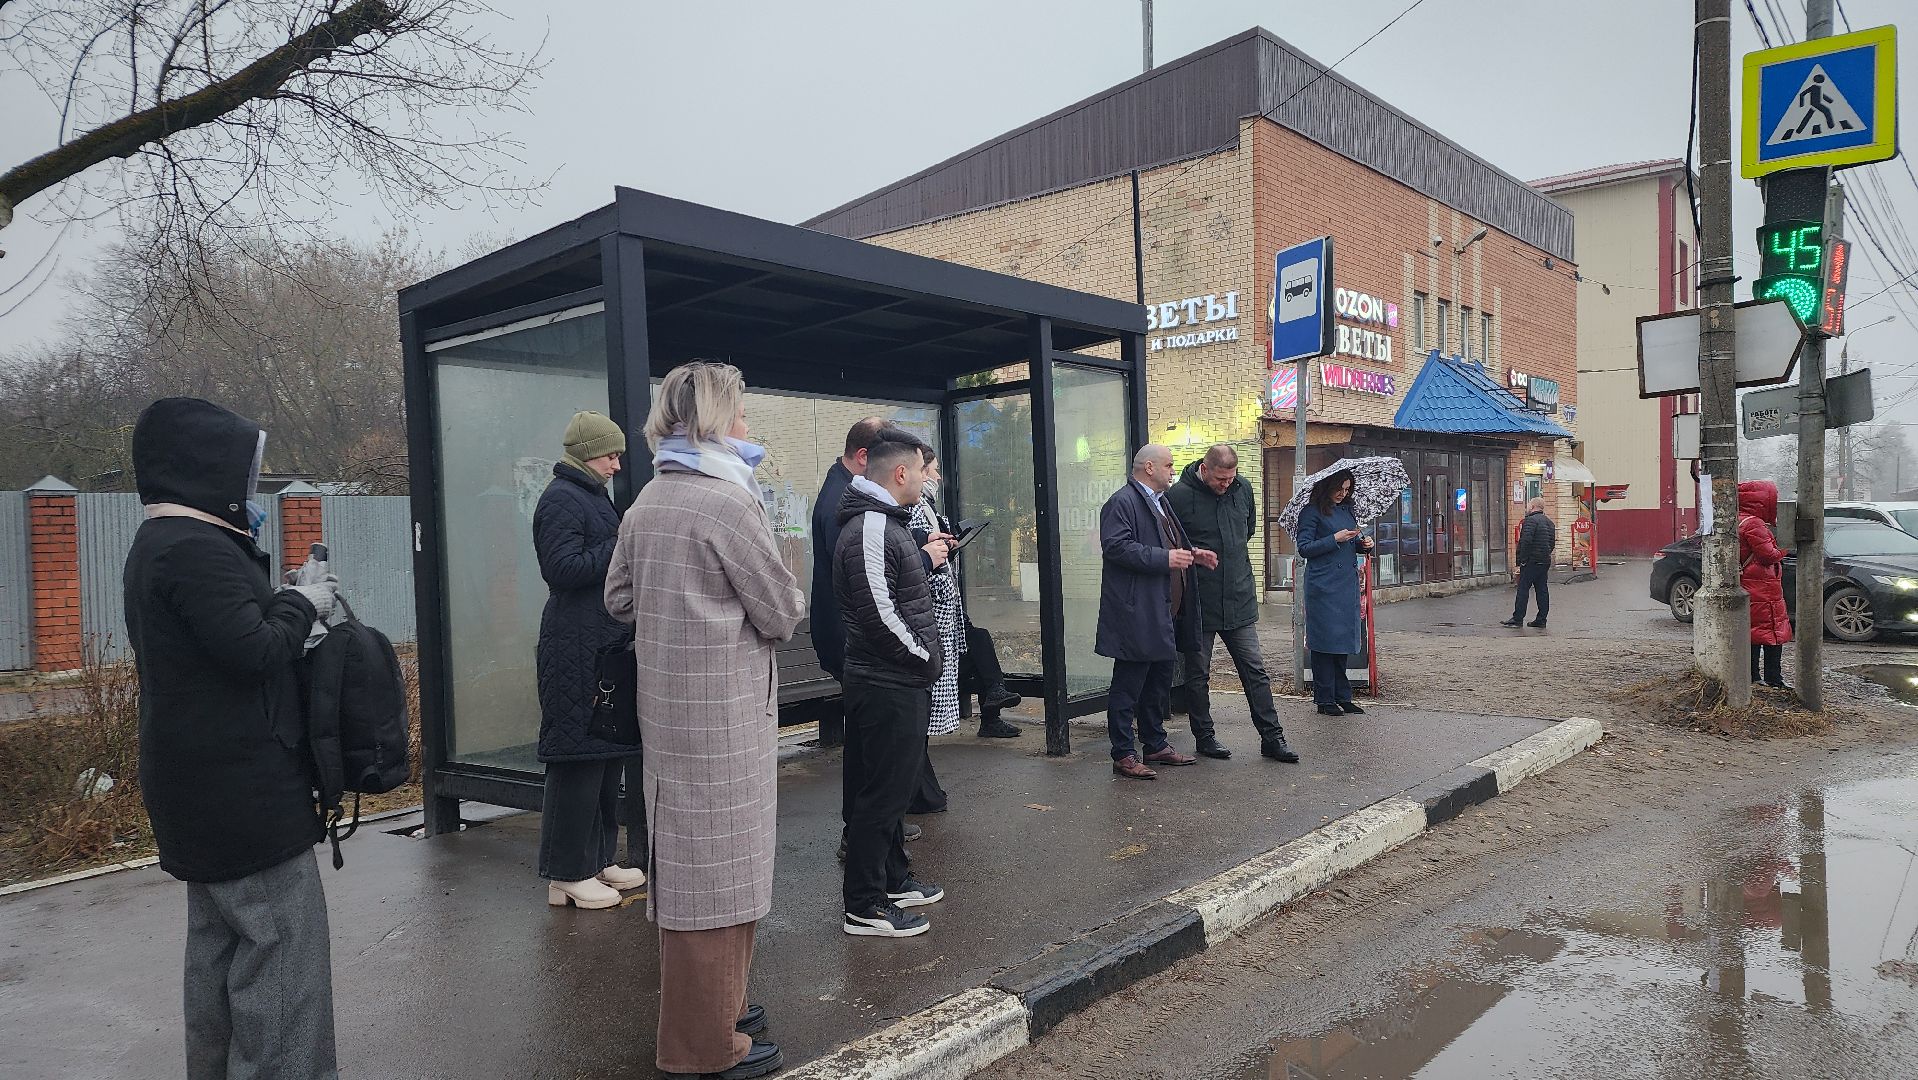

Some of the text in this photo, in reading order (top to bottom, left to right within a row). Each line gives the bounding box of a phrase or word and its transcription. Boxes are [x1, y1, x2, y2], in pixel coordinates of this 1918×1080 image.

[1772, 226, 1821, 270] 45
[1146, 291, 1240, 331] ВЕТЫ
[1335, 287, 1384, 323] OZON
[1167, 327, 1239, 349] ПОДАРКИ
[1331, 324, 1393, 363] ВЕТЫ
[1750, 409, 1779, 418] РАБОТА
